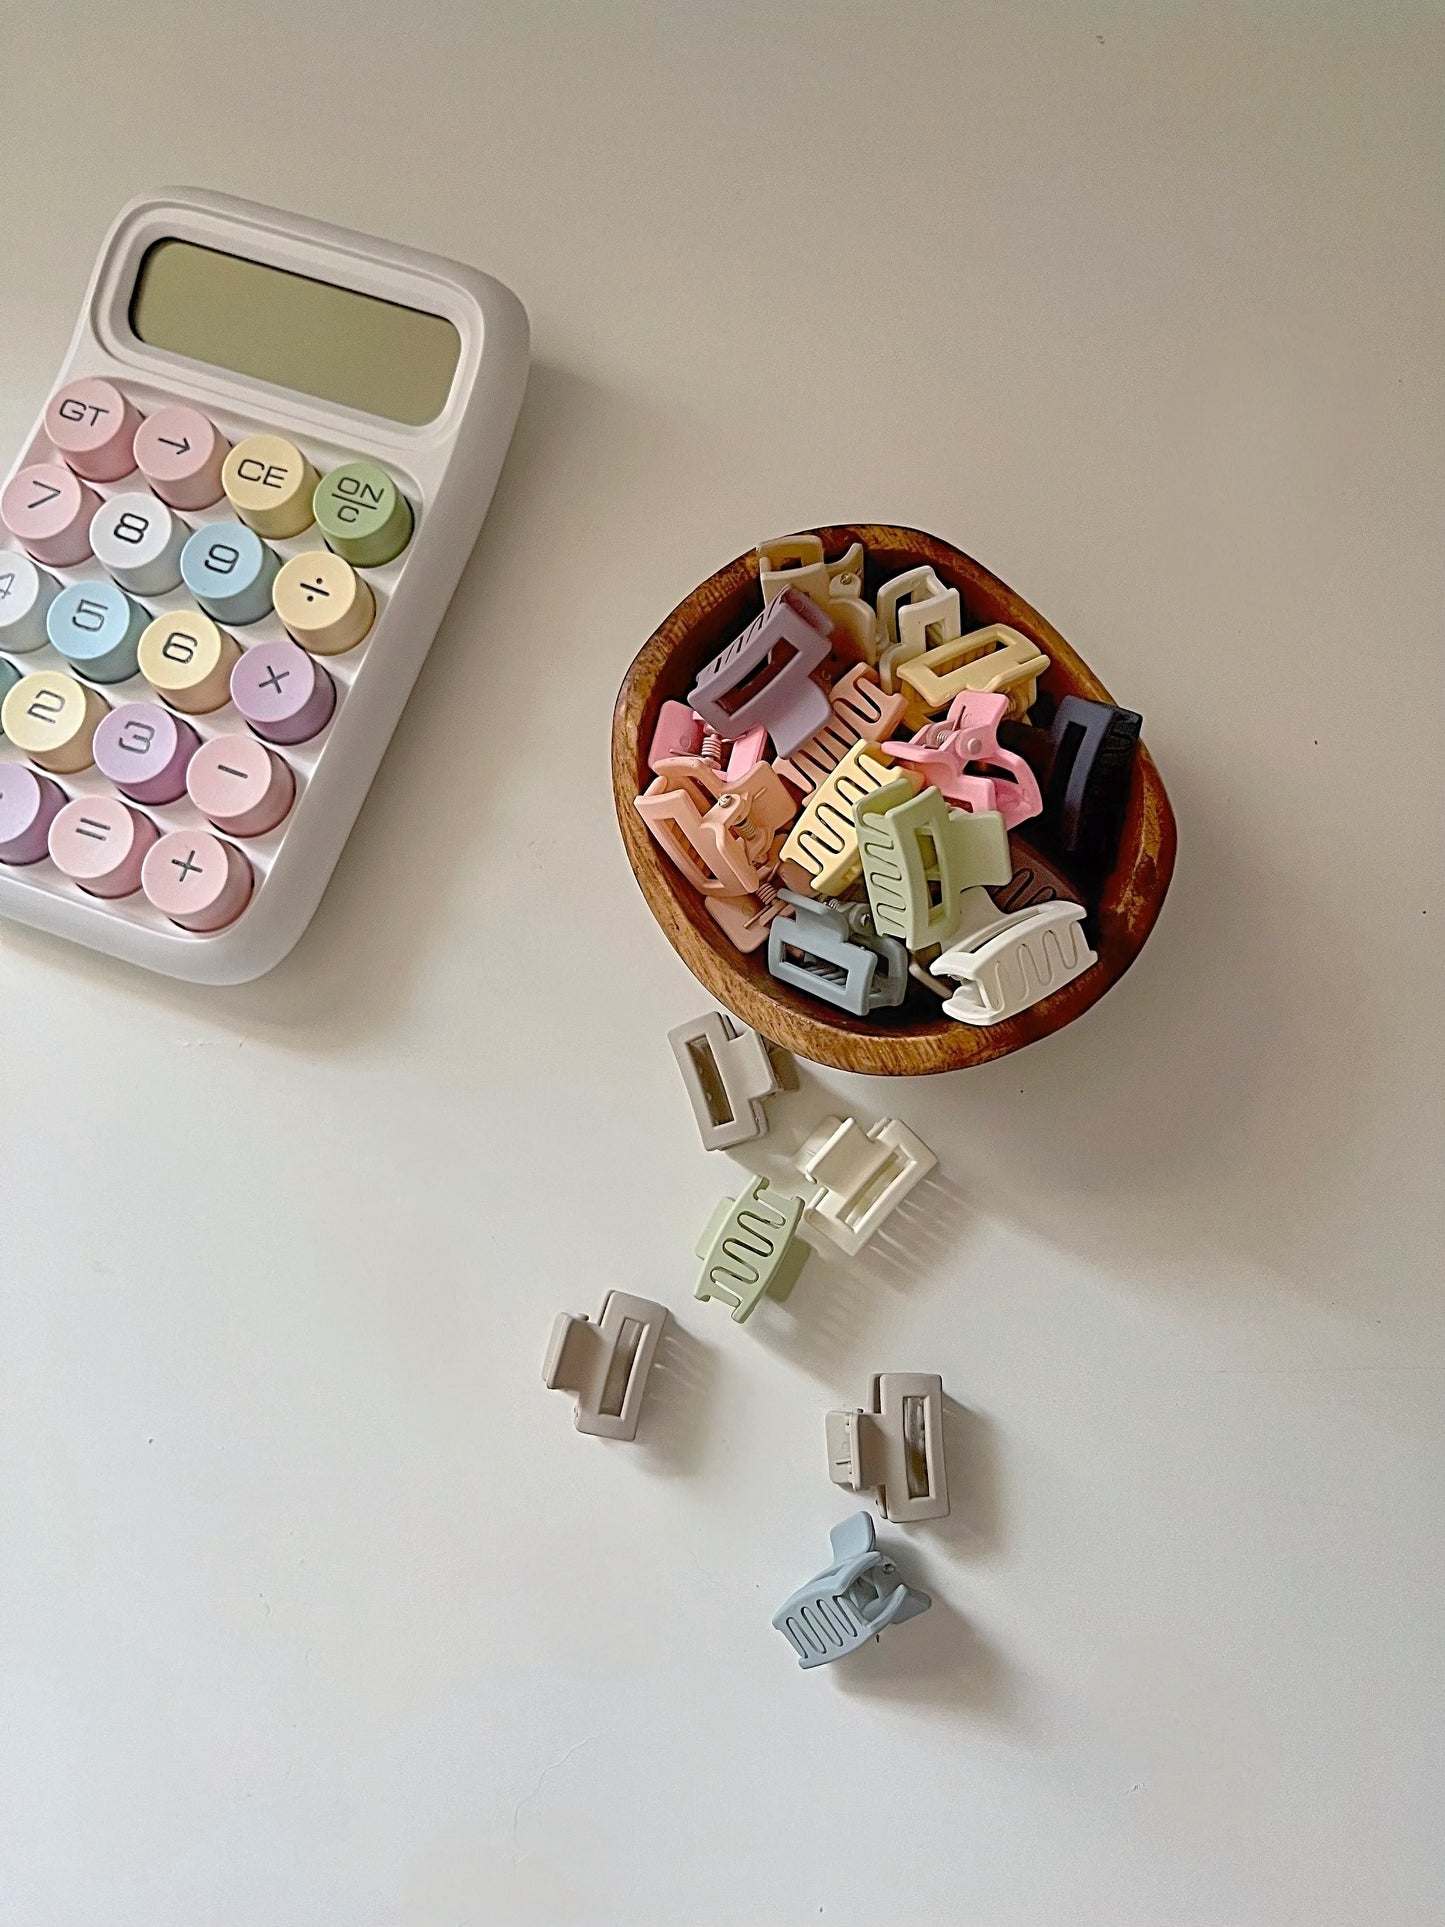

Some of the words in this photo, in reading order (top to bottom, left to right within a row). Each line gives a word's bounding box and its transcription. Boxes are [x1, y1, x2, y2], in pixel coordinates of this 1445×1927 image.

[59, 399, 109, 426] GT
[237, 459, 288, 489] CE
[27, 480, 61, 509] 7
[337, 477, 384, 503] ON
[113, 512, 149, 545] 8
[337, 505, 359, 523] C
[204, 543, 239, 574] 9
[72, 599, 108, 632] 5
[162, 632, 198, 664] 6
[27, 689, 65, 724] 2
[118, 721, 155, 755] 3
